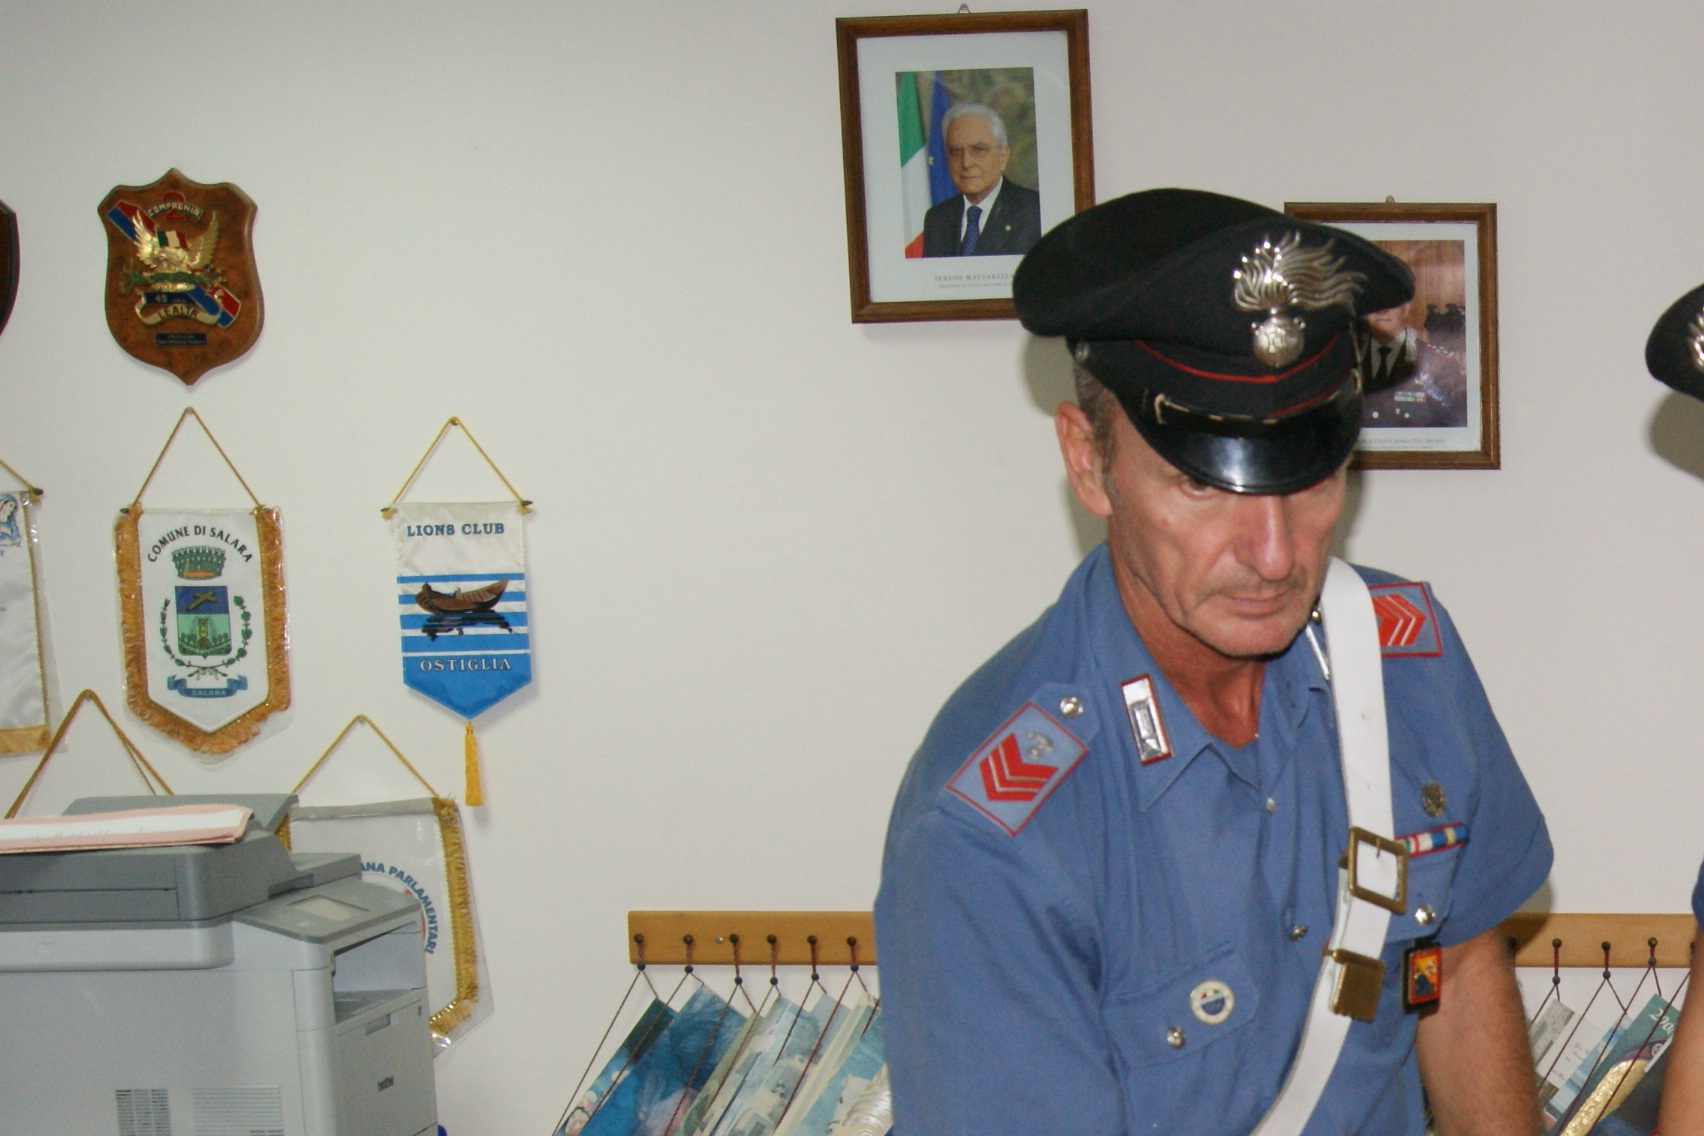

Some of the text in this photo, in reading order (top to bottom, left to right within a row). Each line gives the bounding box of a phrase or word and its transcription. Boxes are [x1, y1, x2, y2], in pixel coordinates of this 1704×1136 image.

[407, 523, 505, 537] LIONS CLUB
[147, 525, 253, 563] COMUNE DI SALARA
[420, 658, 511, 672] OSTIGLIA
[388, 866, 438, 954] PARLAMENTARI
[1649, 1008, 1676, 1035] 200
